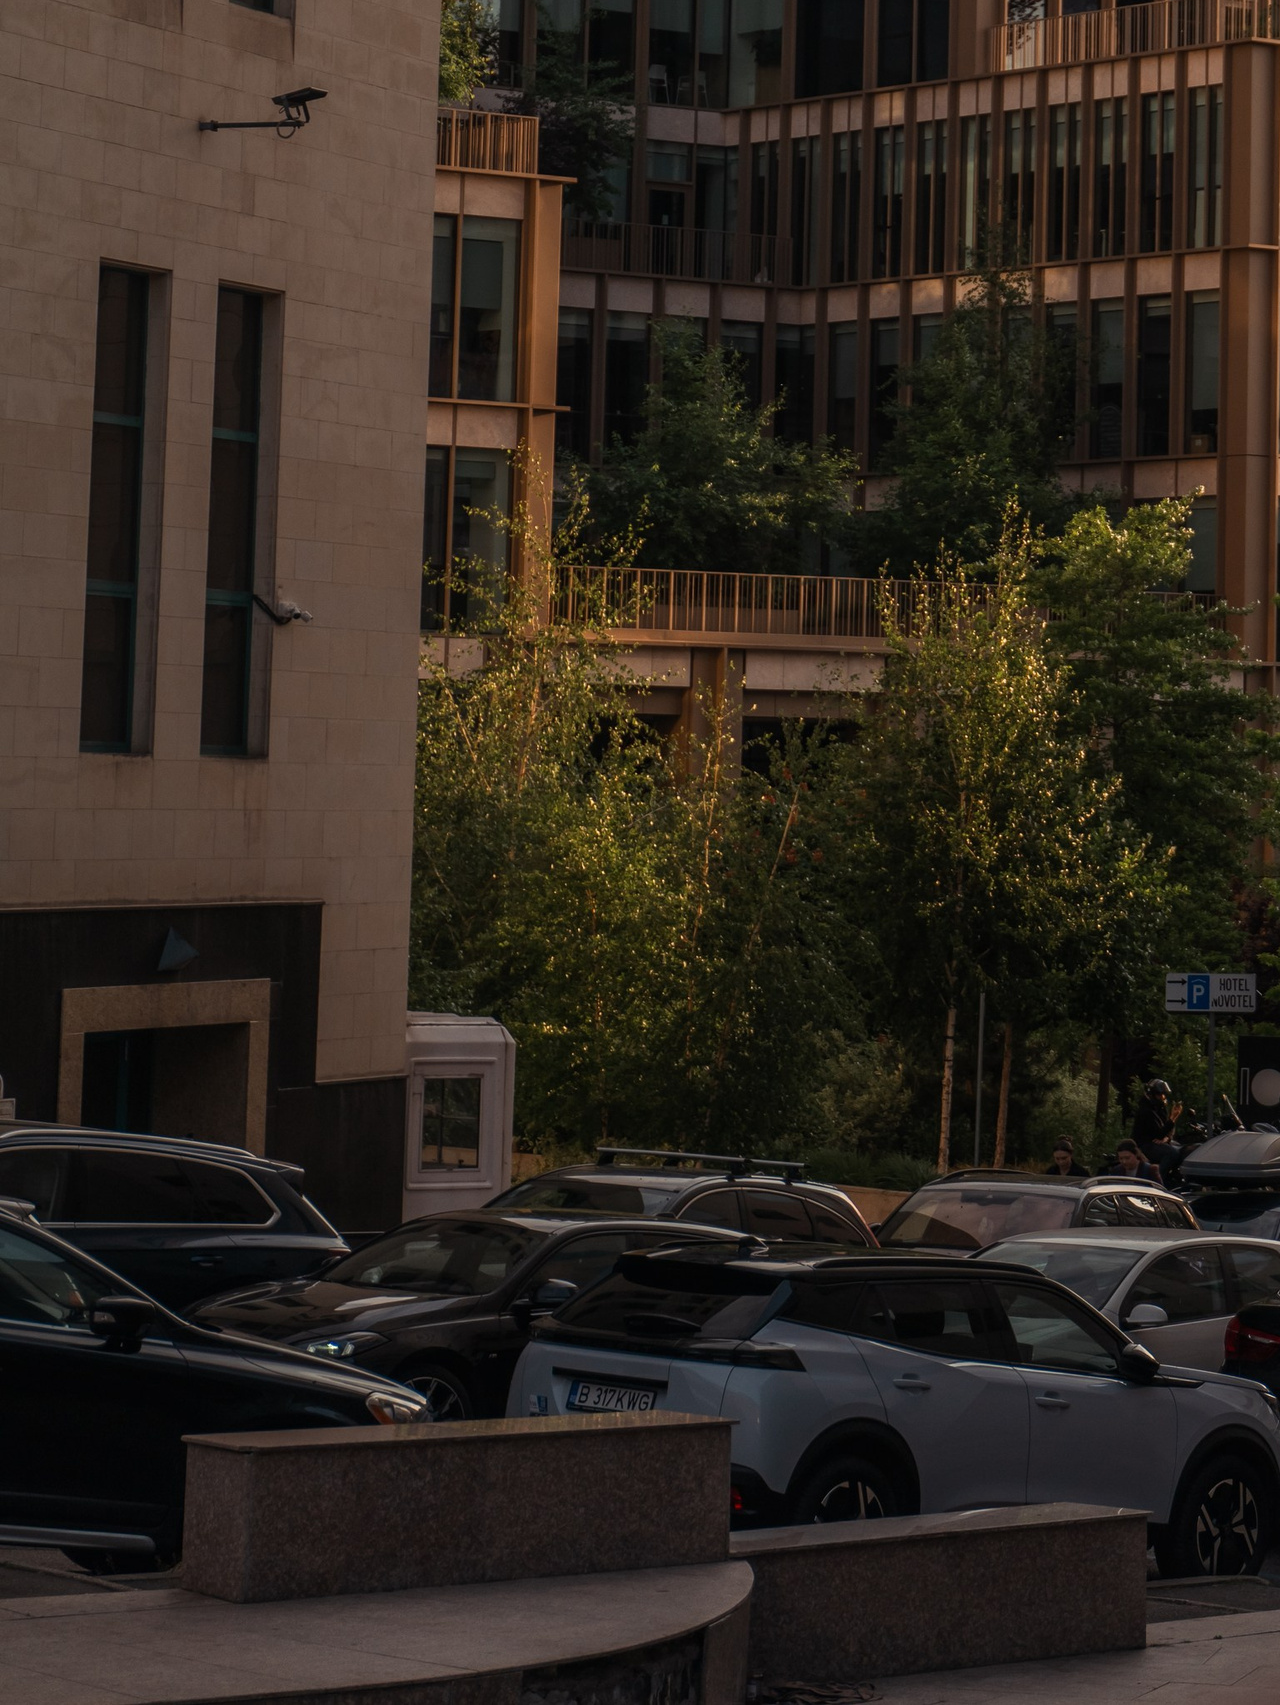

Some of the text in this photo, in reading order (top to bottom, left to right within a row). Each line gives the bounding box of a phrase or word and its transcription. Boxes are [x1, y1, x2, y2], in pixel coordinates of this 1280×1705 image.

[1219, 978, 1250, 991] HOTEL
[1193, 984, 1205, 1004] P
[1211, 994, 1254, 1008] NOVOTEL
[578, 1385, 591, 1404] B
